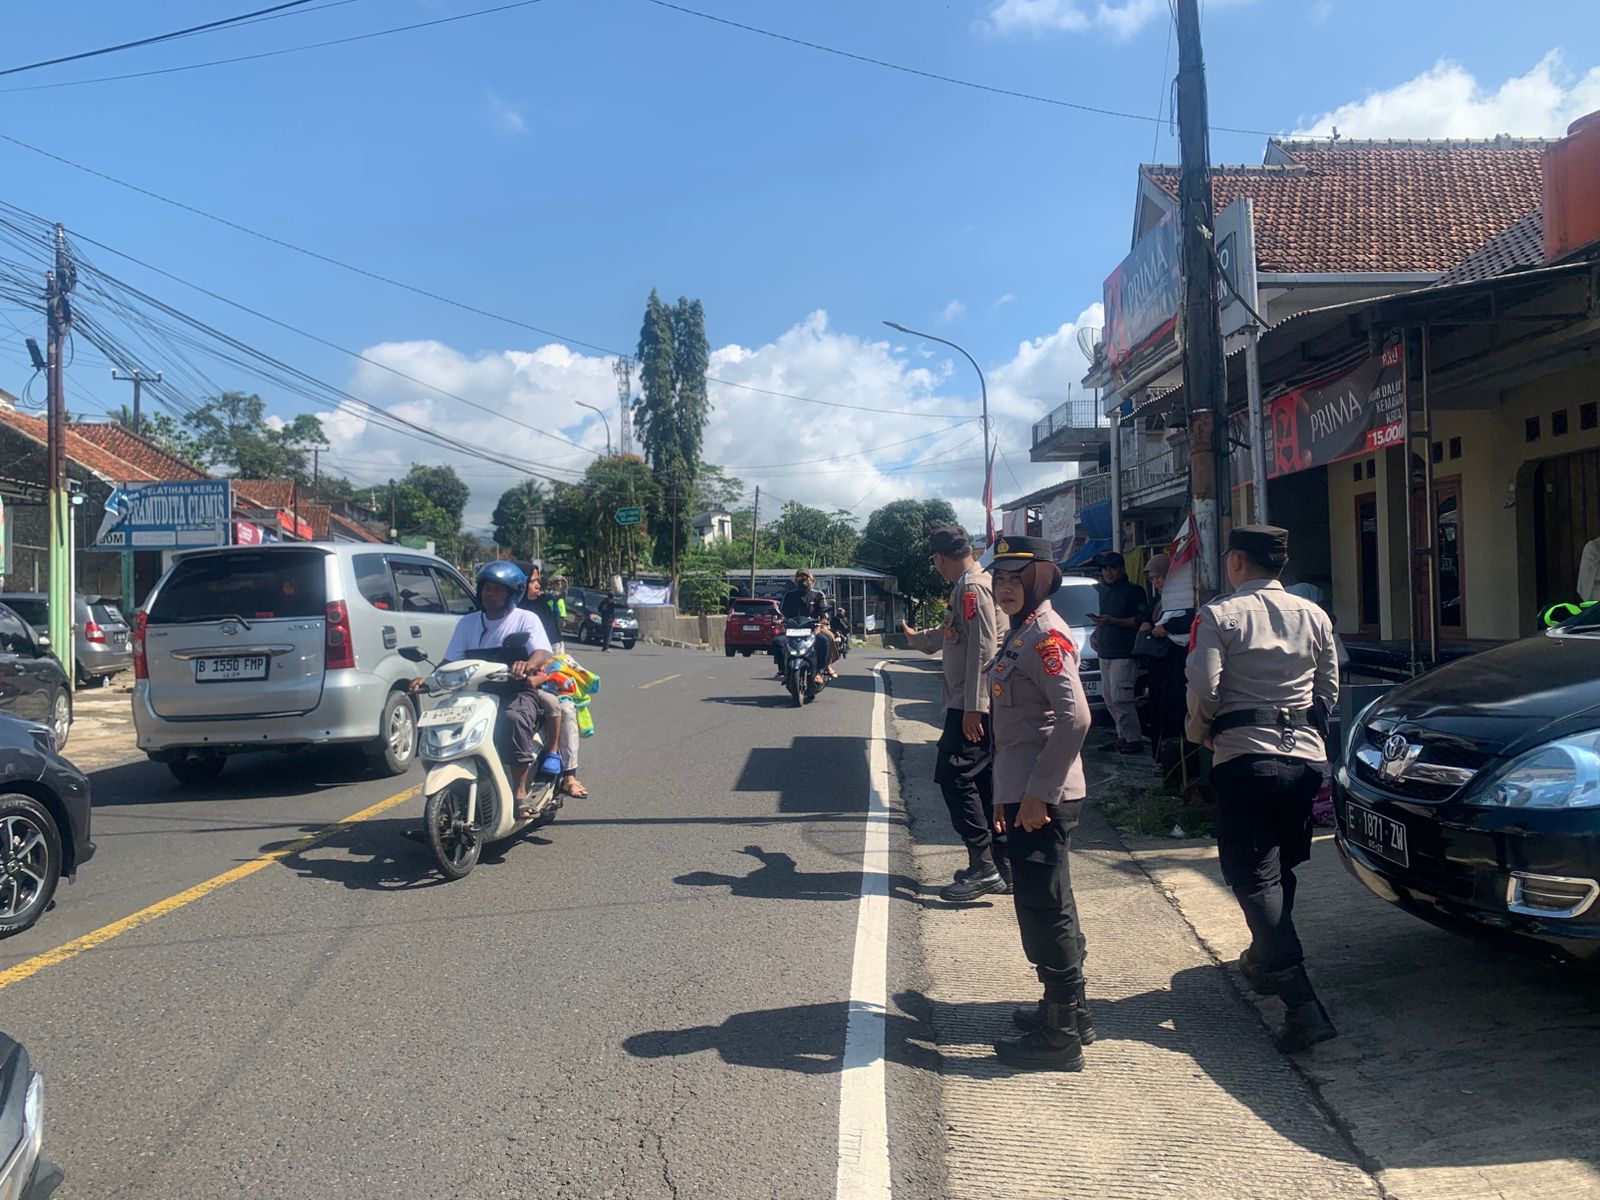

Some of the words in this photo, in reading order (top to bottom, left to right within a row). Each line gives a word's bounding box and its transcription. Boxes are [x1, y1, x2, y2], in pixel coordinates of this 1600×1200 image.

[1127, 244, 1168, 316] PRIMA
[1310, 390, 1363, 442] PRIMA
[141, 485, 191, 496] PELATIHAN
[193, 484, 223, 494] KERJA
[124, 495, 185, 526] PRAMUDITA
[187, 494, 225, 522] CIAMIS
[198, 660, 206, 673] B
[212, 659, 239, 673] 1550
[244, 658, 263, 671] FMP
[1348, 804, 1355, 829] E
[1363, 811, 1383, 842] 1871
